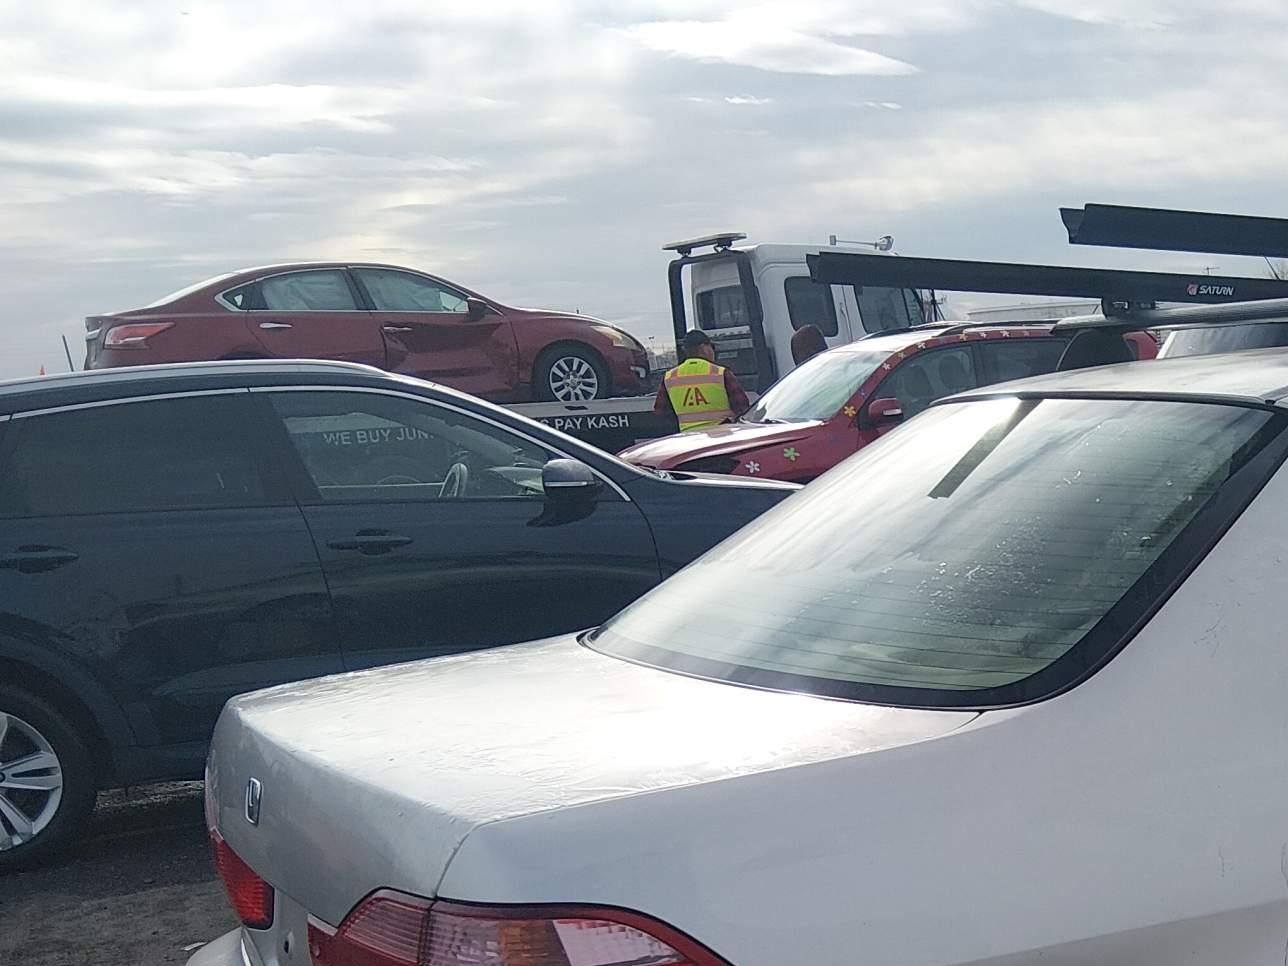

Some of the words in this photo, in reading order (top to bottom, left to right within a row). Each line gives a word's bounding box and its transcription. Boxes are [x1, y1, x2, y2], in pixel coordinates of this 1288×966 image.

[1199, 285, 1234, 296] SATURN
[323, 431, 352, 445] WE
[356, 428, 390, 443] BUY
[554, 418, 582, 430] PAY
[587, 415, 629, 429] KASH
